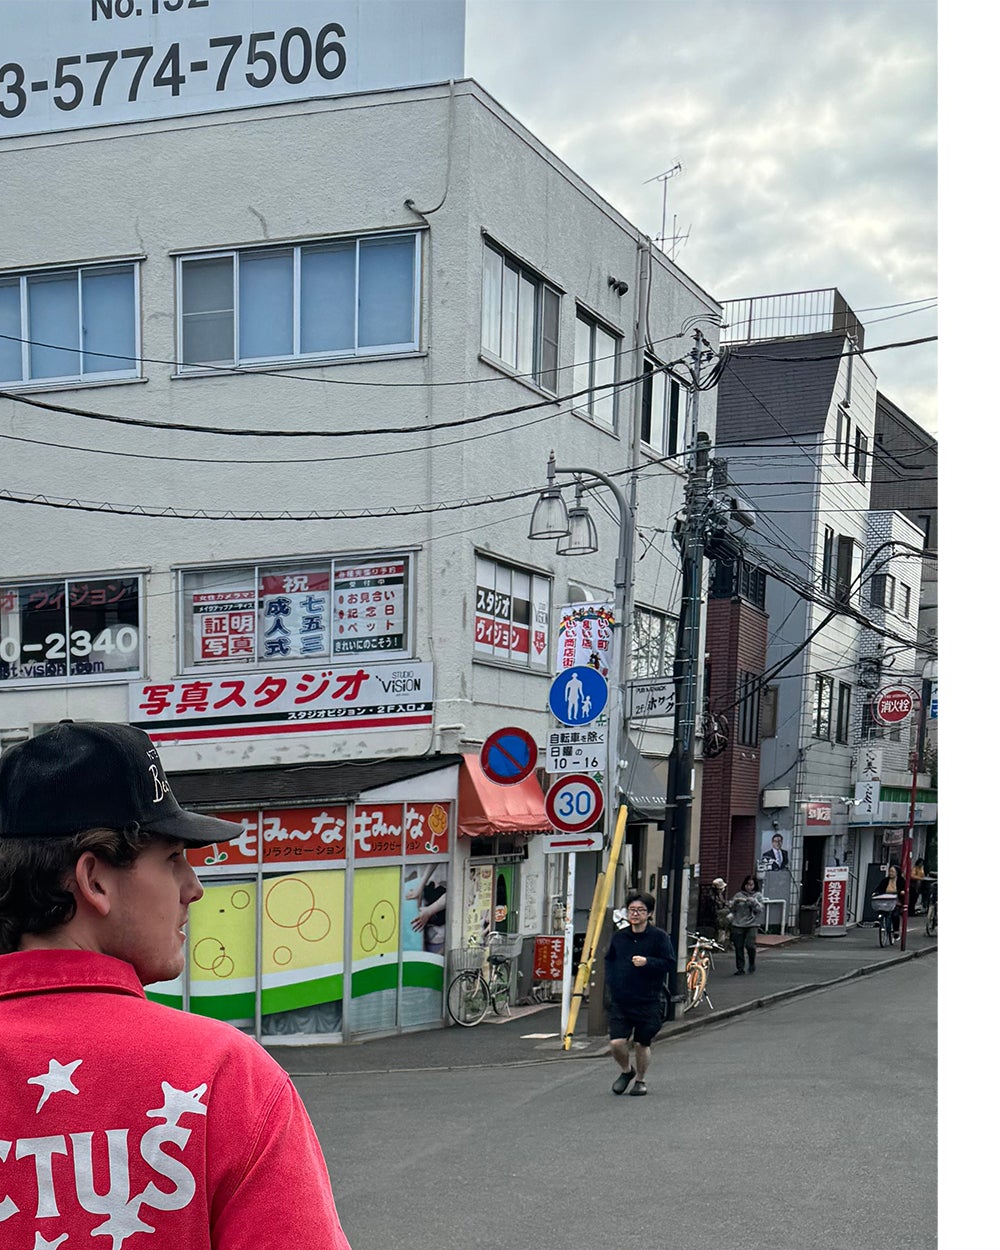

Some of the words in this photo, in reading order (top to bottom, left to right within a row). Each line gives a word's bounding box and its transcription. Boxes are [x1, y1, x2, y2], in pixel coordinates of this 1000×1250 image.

[282, 576, 310, 593] 祝
[347, 591, 395, 604] お見合い
[477, 589, 510, 617] スタジオ
[347, 604, 395, 619] 記念日
[204, 611, 255, 635] 証明
[264, 596, 292, 657] 成人式
[299, 594, 326, 654] 七五三
[476, 620, 520, 648] ヴィジョン
[204, 636, 255, 656] 写真
[139, 669, 370, 715] 写真スタジオ
[880, 699, 910, 713] 消火栓
[550, 731, 604, 744] 自転車を除く
[551, 746, 583, 757] 日曜の
[559, 791, 591, 817] 30
